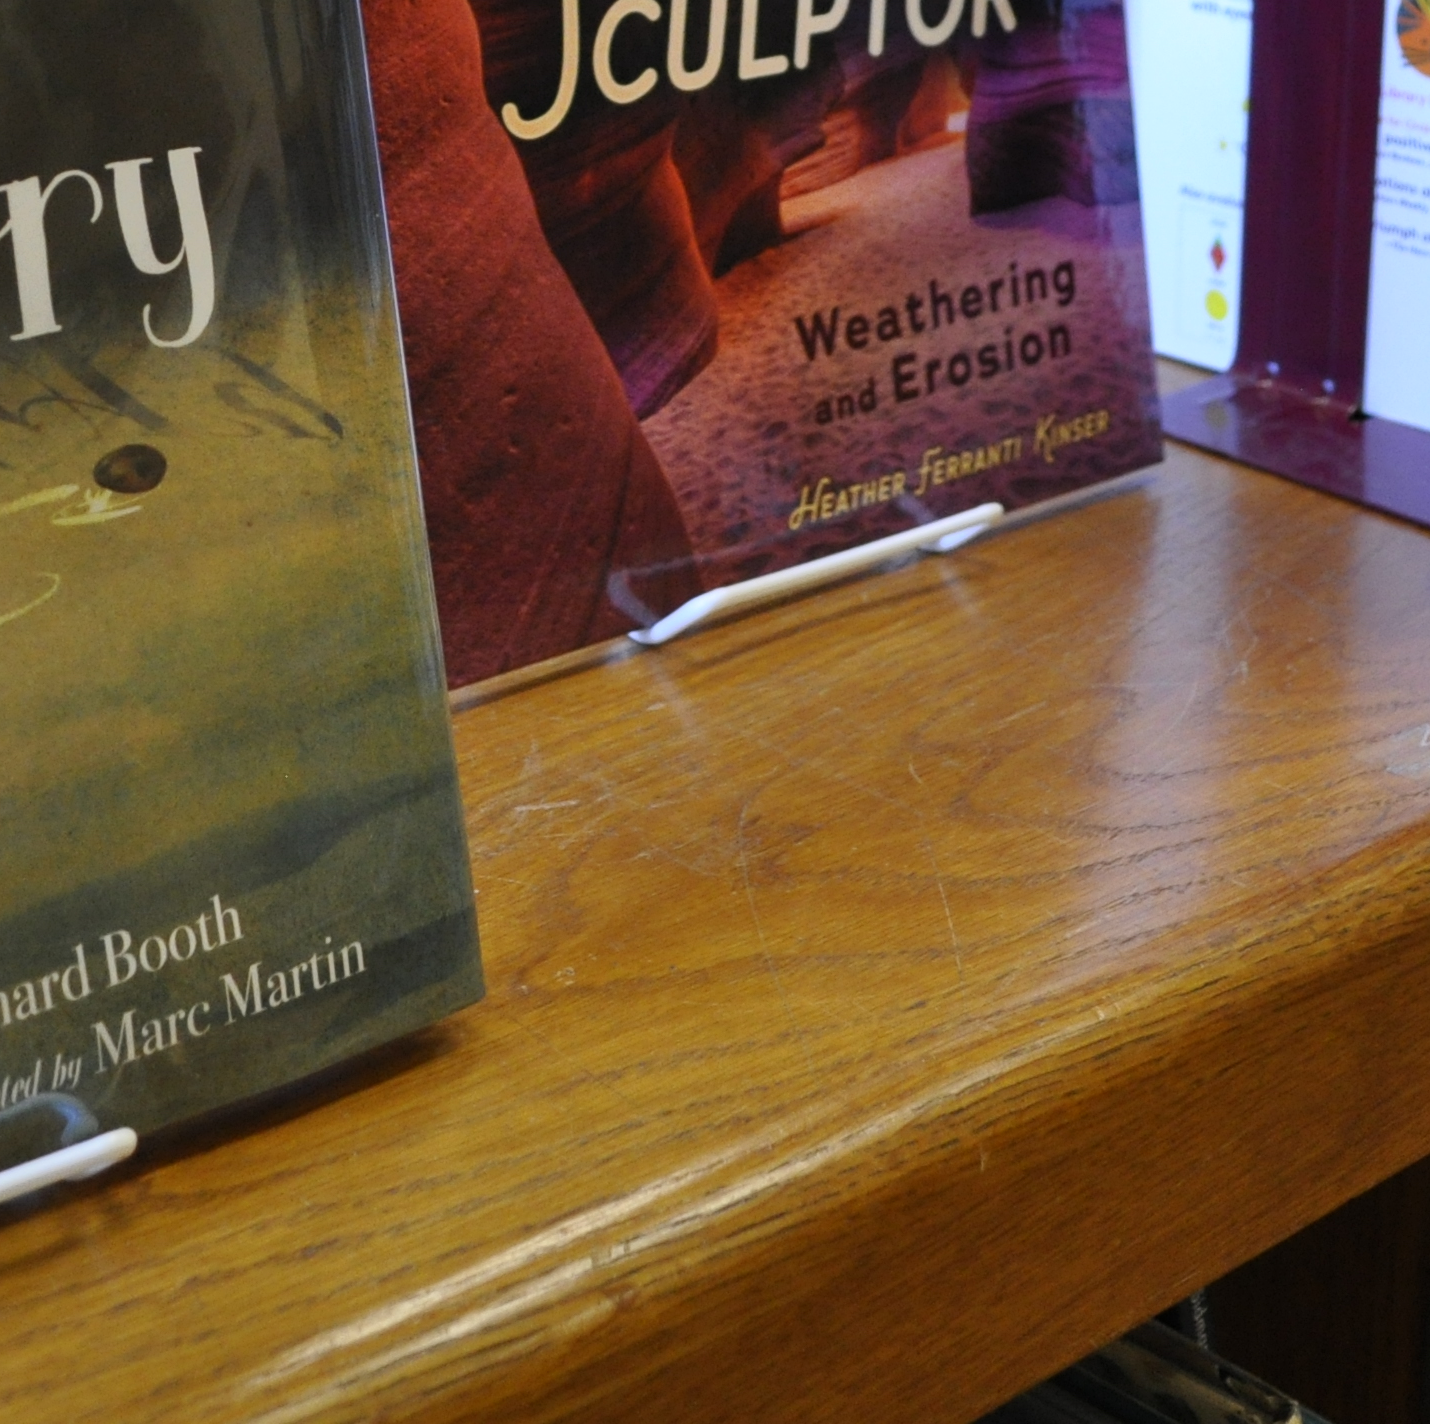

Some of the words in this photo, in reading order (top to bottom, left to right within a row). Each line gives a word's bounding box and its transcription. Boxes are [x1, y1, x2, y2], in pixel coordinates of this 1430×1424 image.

[793, 258, 1078, 362] Weathering
[813, 375, 878, 427] and
[890, 322, 1072, 404] Erosion
[788, 471, 906, 532] HEATHER
[914, 437, 1024, 496] FERRANTI
[1033, 409, 1111, 463] KINSER
[99, 893, 247, 987] Booth
[51, 1052, 83, 1091] by
[92, 995, 213, 1076] Marc
[222, 934, 369, 1029] Martin
